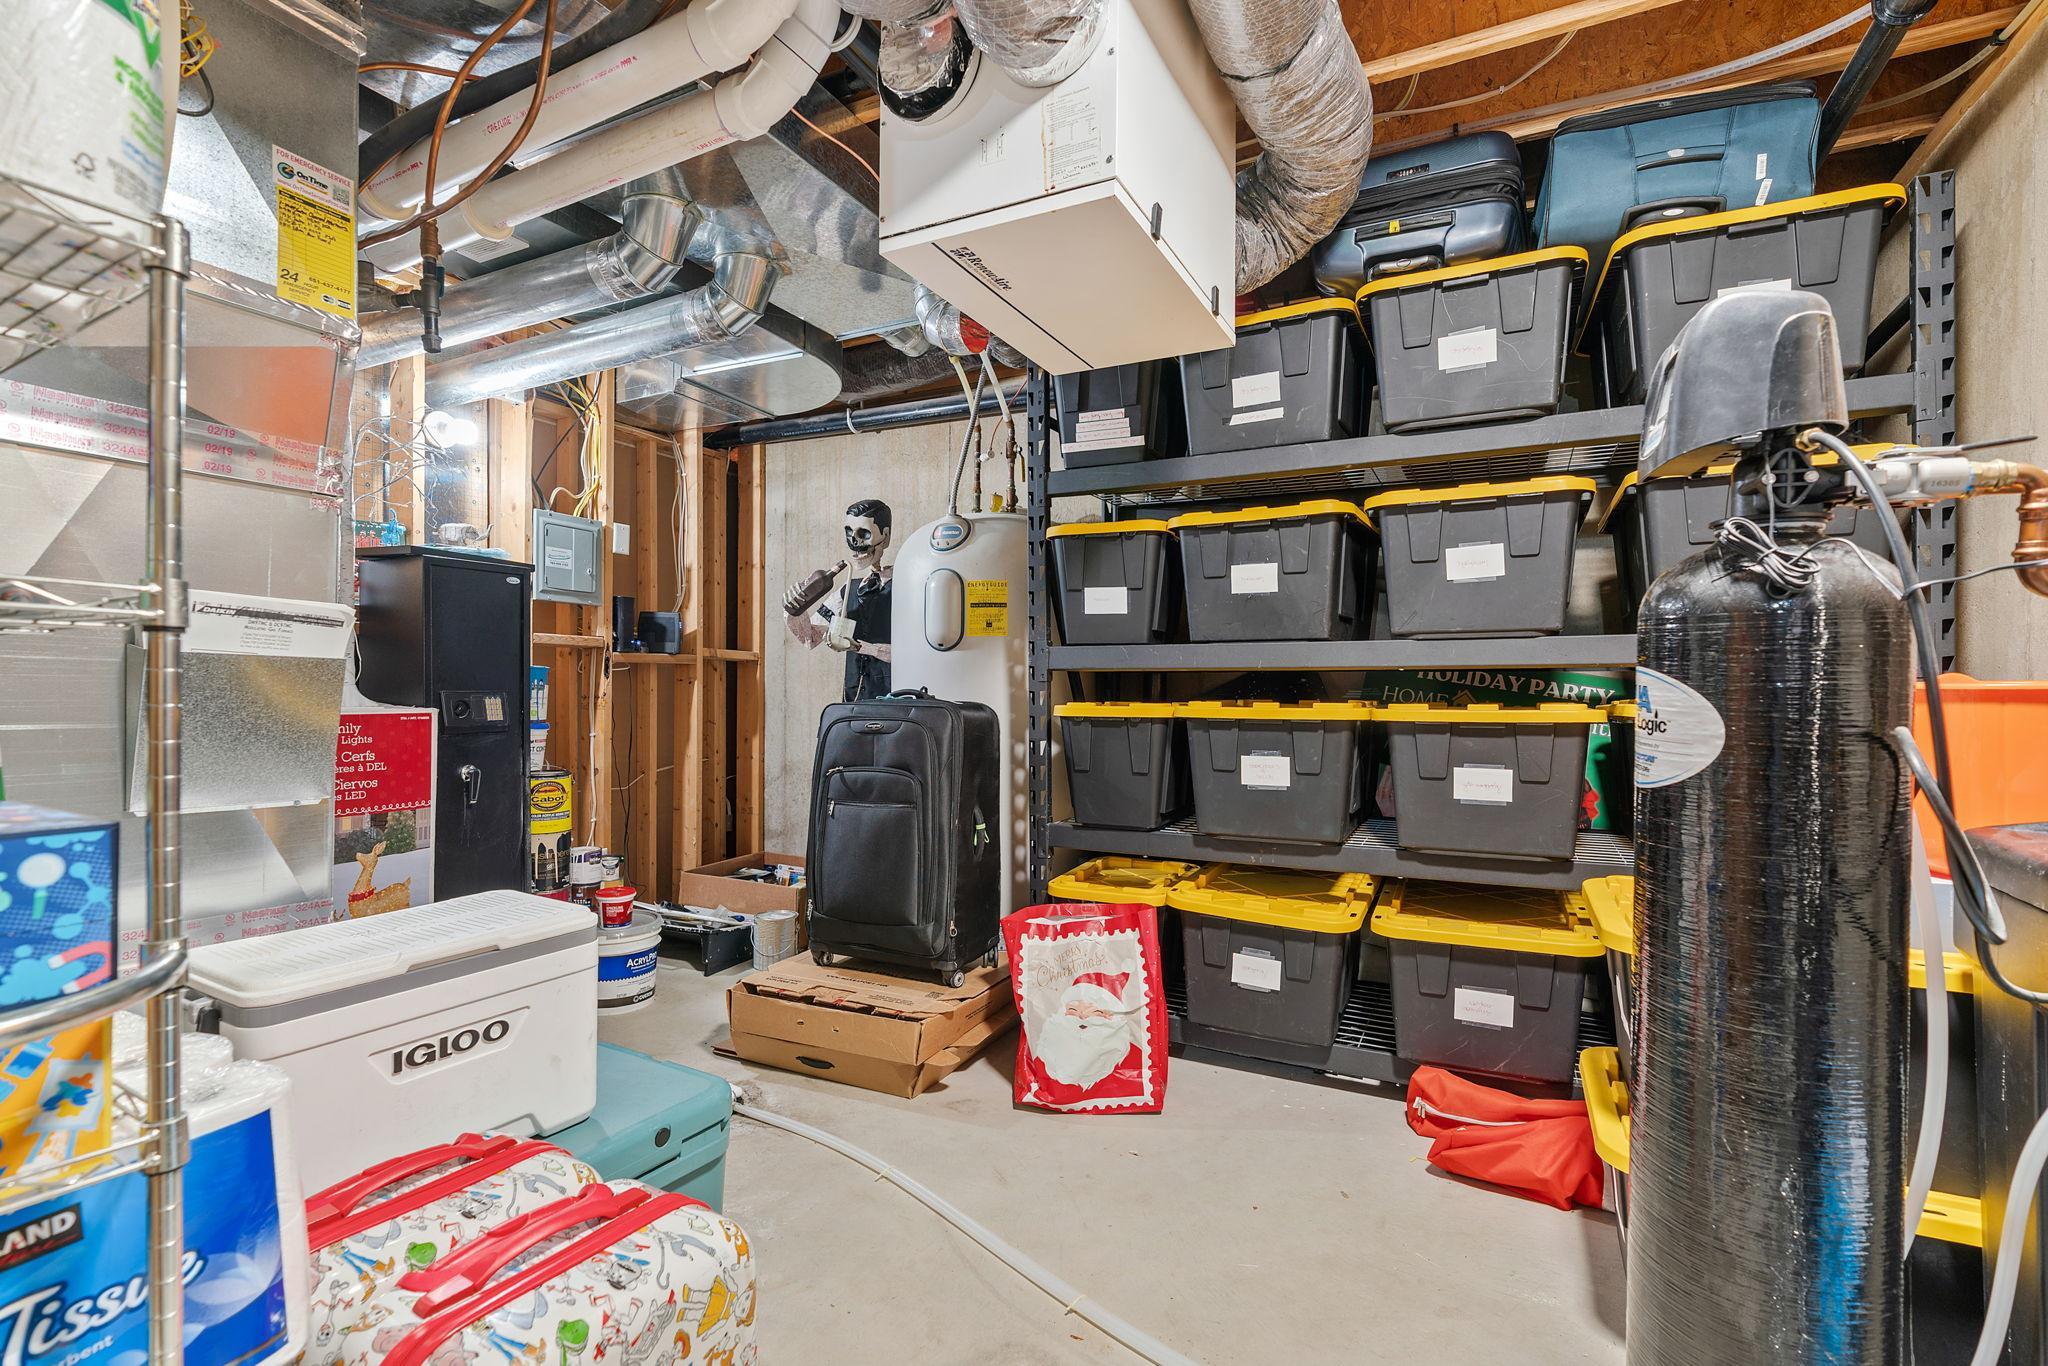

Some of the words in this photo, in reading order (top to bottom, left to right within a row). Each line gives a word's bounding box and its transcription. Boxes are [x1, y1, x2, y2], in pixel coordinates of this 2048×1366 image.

[276, 148, 290, 160] FOR
[290, 156, 327, 177] EMERGENCY
[327, 170, 351, 188] SERVICE
[280, 268, 299, 283] 24
[283, 280, 316, 294] EMERGENCY
[288, 287, 310, 297] SERVICE
[207, 424, 236, 438] 02/19
[204, 443, 233, 456] 02/19
[203, 461, 233, 474] 02/19
[203, 607, 237, 615] DAIKIN
[1382, 685, 1449, 703] HOME
[1416, 671, 1526, 693] HOLIDAY
[1529, 678, 1617, 705] PARTY
[341, 736, 373, 746] Lights
[341, 750, 376, 762] Cerfs
[357, 763, 364, 772] à
[366, 762, 387, 771] DEL
[345, 791, 367, 800] LED
[531, 795, 565, 803] Cabot
[1055, 945, 1081, 964] MERRY
[1037, 950, 1105, 987] Christmas
[392, 1020, 510, 1075] IGLOO
[0, 1211, 77, 1255] AND
